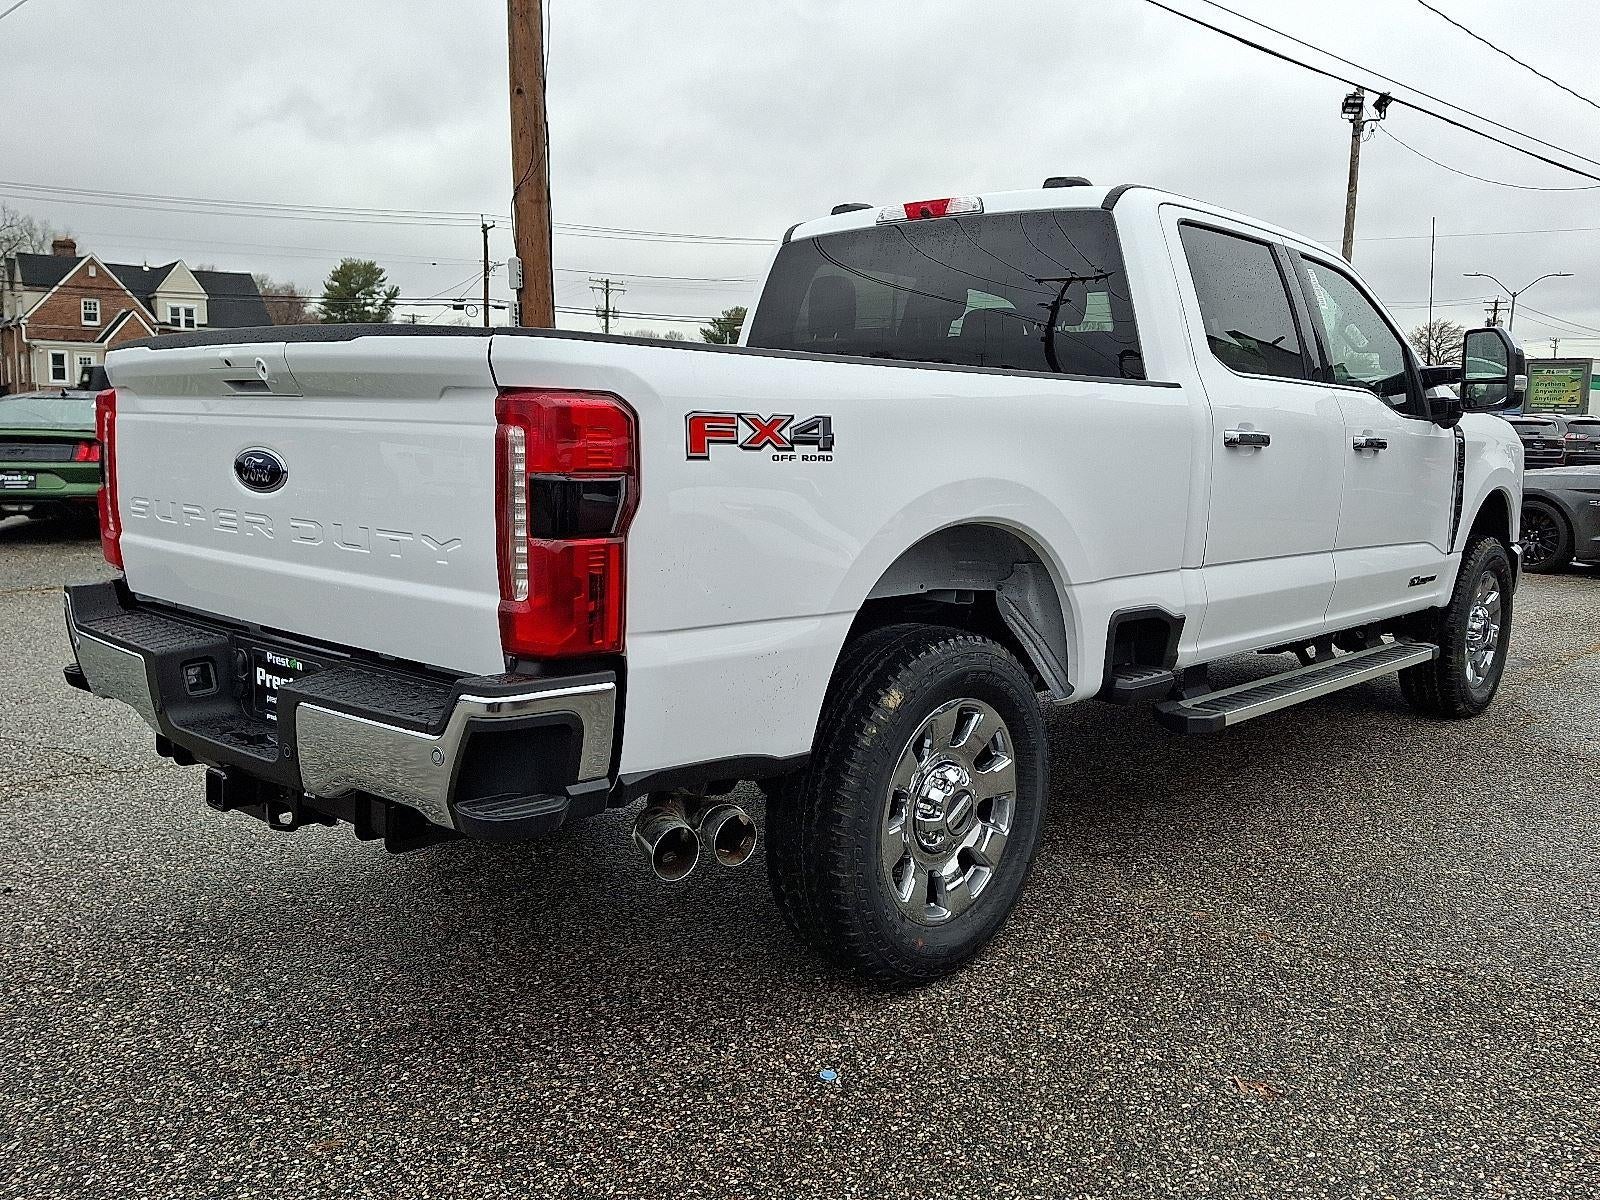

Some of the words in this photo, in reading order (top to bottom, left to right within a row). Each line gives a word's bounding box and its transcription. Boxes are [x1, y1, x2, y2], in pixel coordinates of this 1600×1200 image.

[685, 410, 834, 461] FX4
[241, 456, 271, 483] Ford
[771, 454, 797, 462] OFF
[801, 454, 833, 462] ROAD
[130, 496, 274, 539] SUPER
[290, 517, 462, 564] DUTY
[267, 652, 302, 671] Preston
